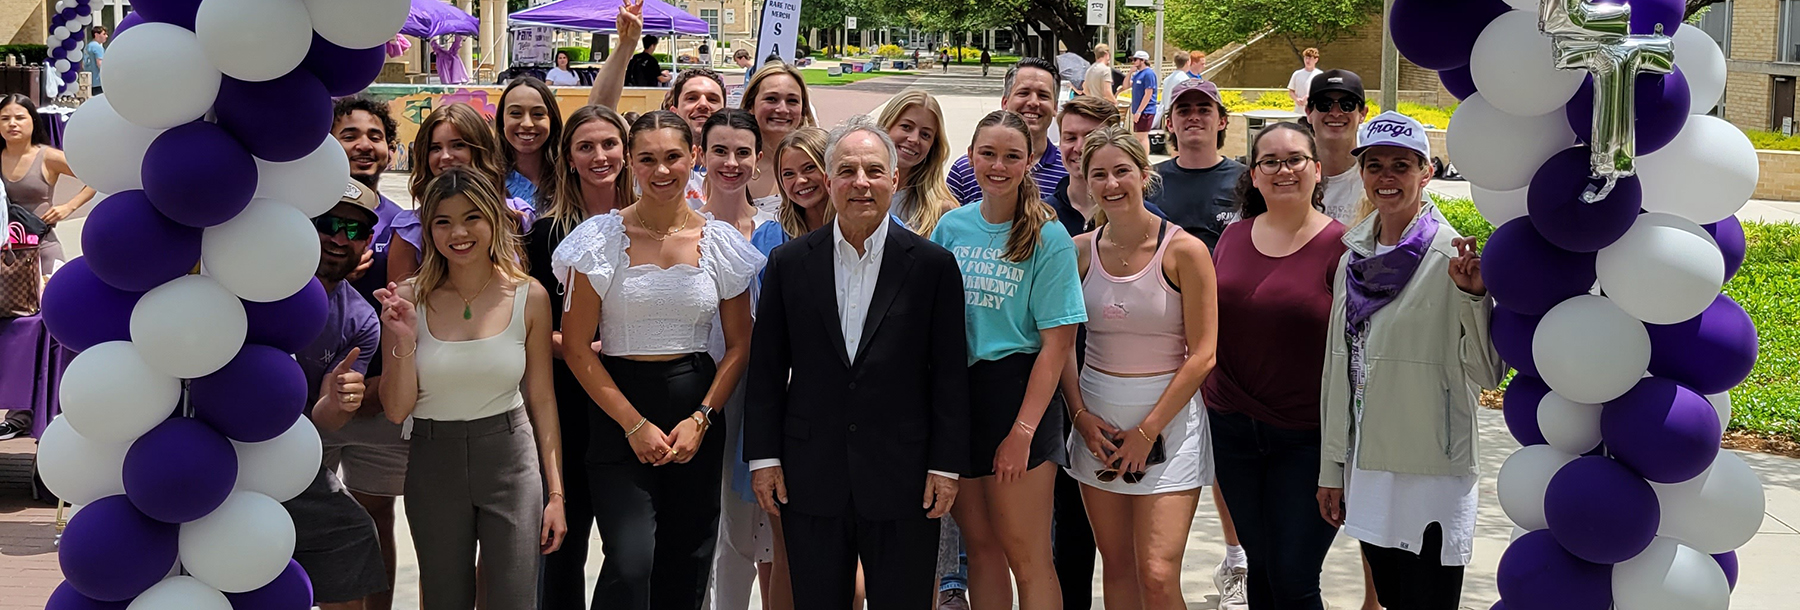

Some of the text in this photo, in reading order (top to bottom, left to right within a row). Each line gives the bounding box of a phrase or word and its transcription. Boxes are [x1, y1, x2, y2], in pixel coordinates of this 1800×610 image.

[771, 10, 791, 20] MERCH
[784, 3, 796, 12] TCU
[1366, 119, 1413, 139] Frogs
[982, 247, 1021, 265] GO
[966, 260, 995, 276] FOR
[964, 290, 1005, 311] ELRY
